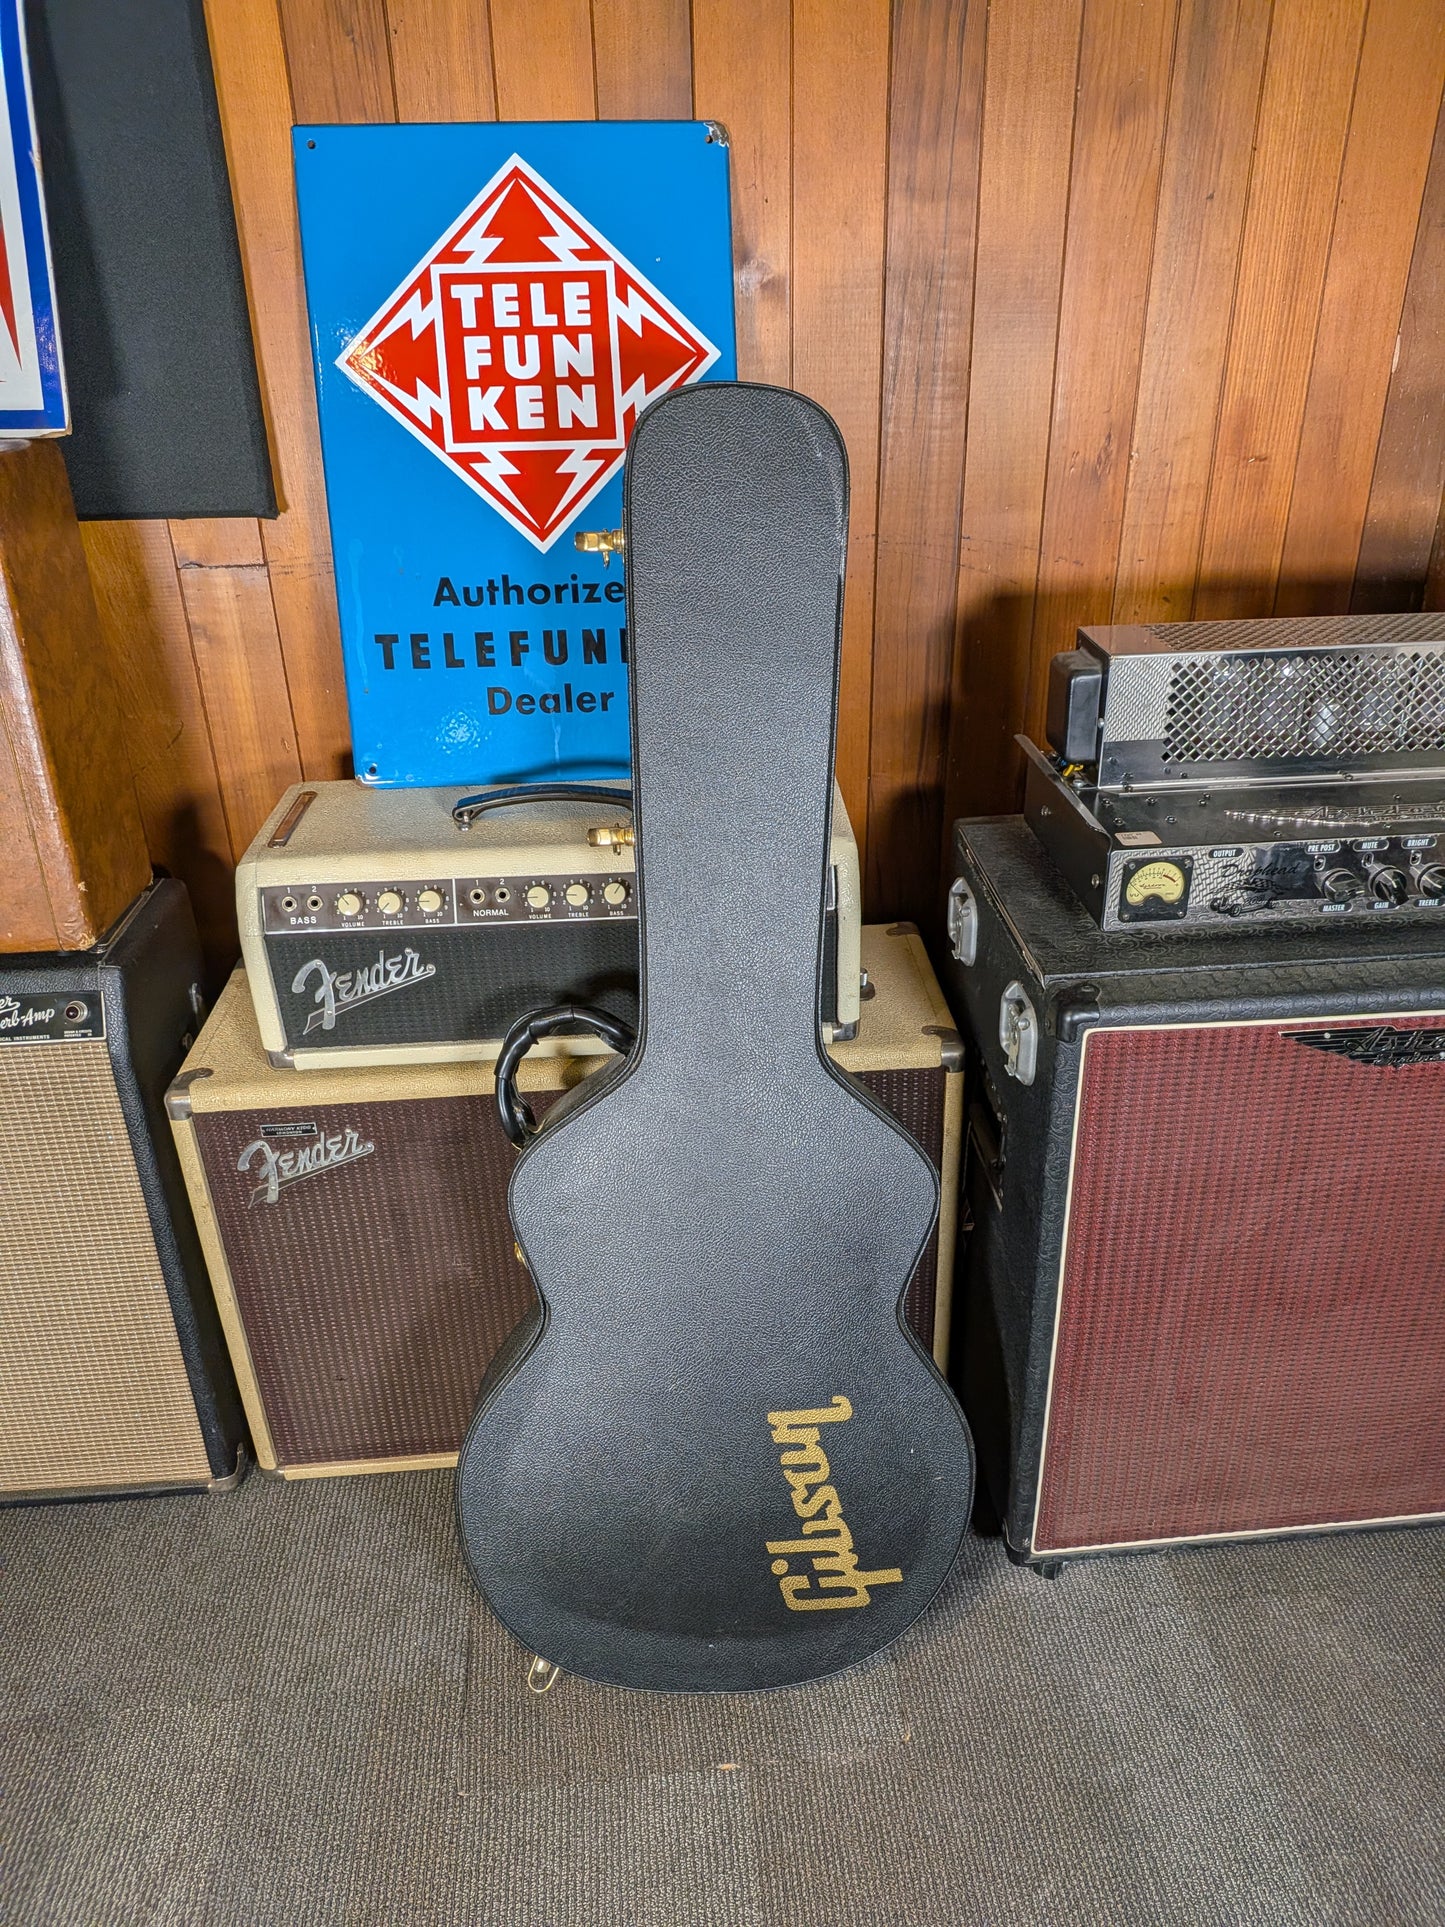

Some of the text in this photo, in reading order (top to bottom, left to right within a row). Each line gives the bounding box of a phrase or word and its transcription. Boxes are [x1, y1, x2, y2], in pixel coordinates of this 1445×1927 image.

[451, 282, 591, 328] TELE
[463, 333, 595, 380] FUN
[467, 384, 598, 430] KEN
[486, 683, 614, 715] Dealer
[1362, 841, 1378, 849] MUTE
[1407, 838, 1429, 847] BRIGHT
[1213, 849, 1237, 857] OUTPUT
[311, 885, 317, 893] 2
[473, 908, 509, 917] NORMAL
[1322, 904, 1346, 912] MASTER
[290, 916, 317, 925] BASS
[292, 948, 436, 1030] Fender
[237, 1129, 374, 1204] Fender
[766, 1395, 903, 1611] Gibson
